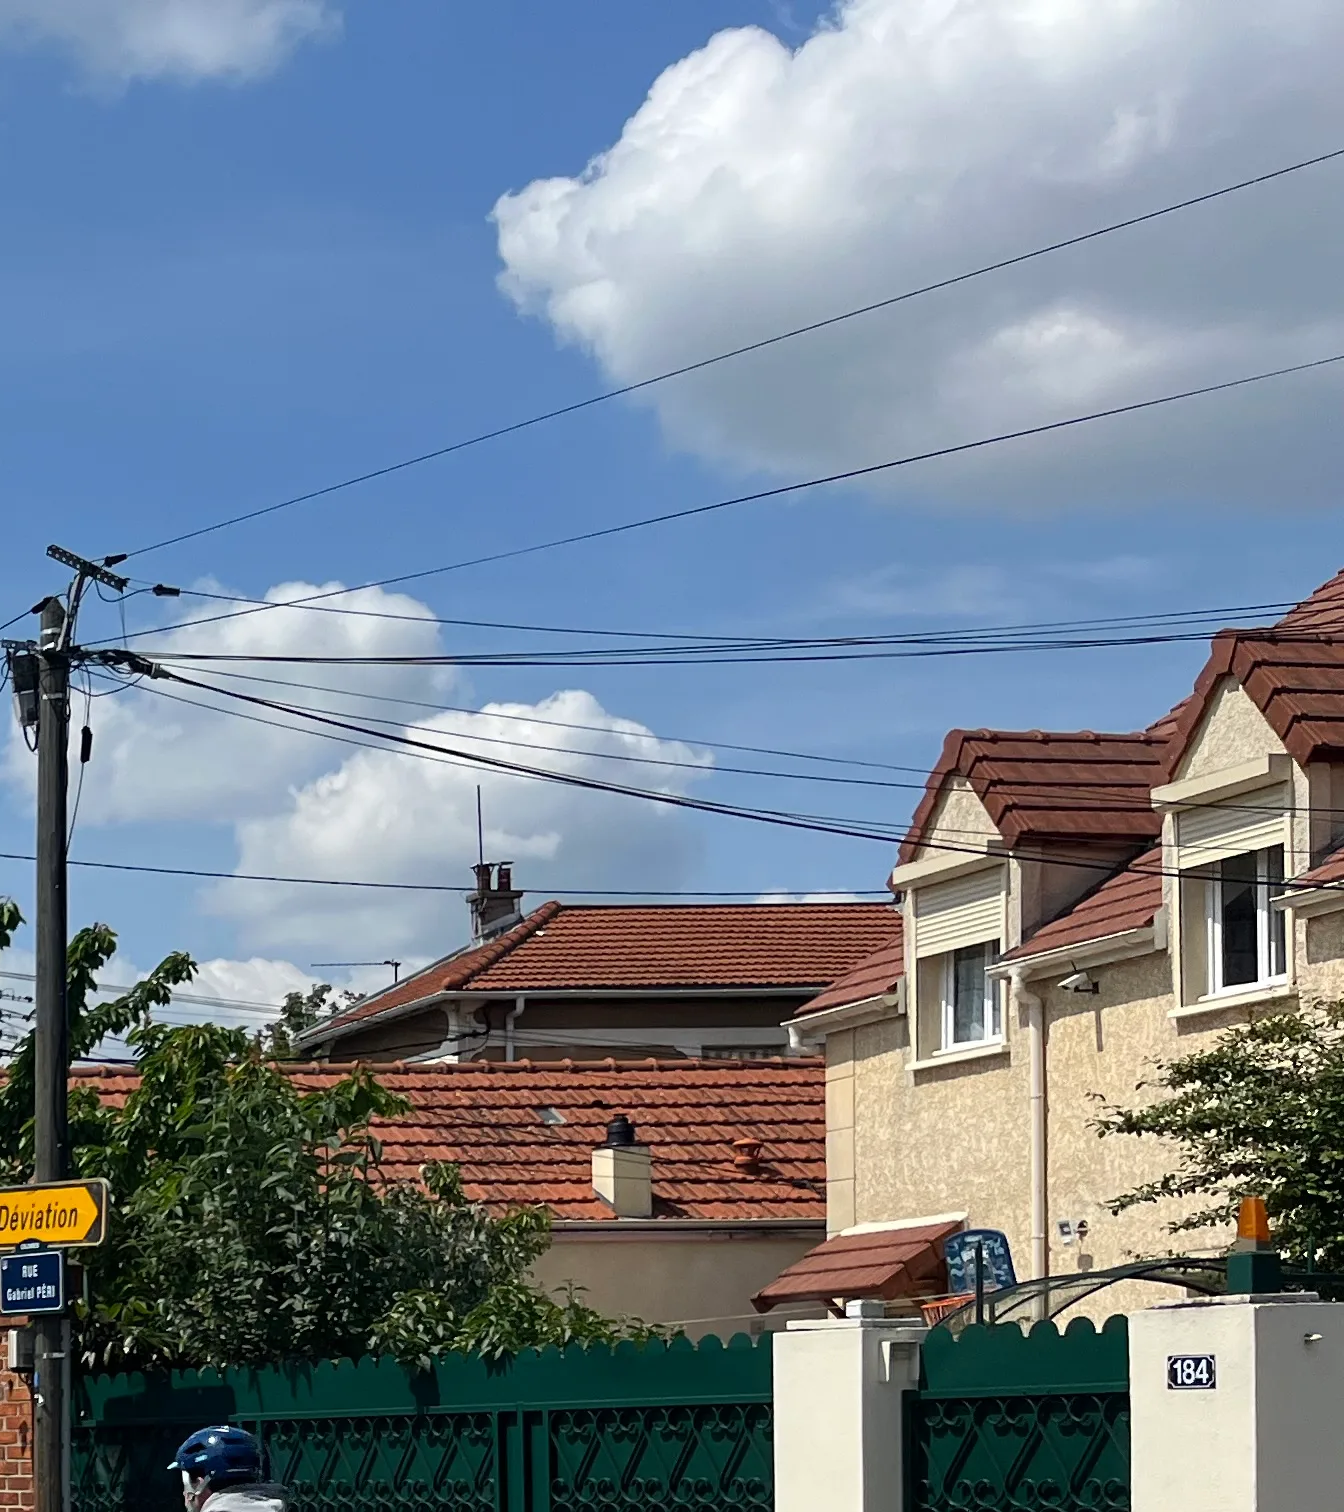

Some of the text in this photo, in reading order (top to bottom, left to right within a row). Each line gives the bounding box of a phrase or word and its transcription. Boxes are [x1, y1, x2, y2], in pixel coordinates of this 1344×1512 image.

[22, 1264, 38, 1278] RUE
[7, 1283, 55, 1301] Gabriel PÉRI
[1173, 1359, 1209, 1384] 184
